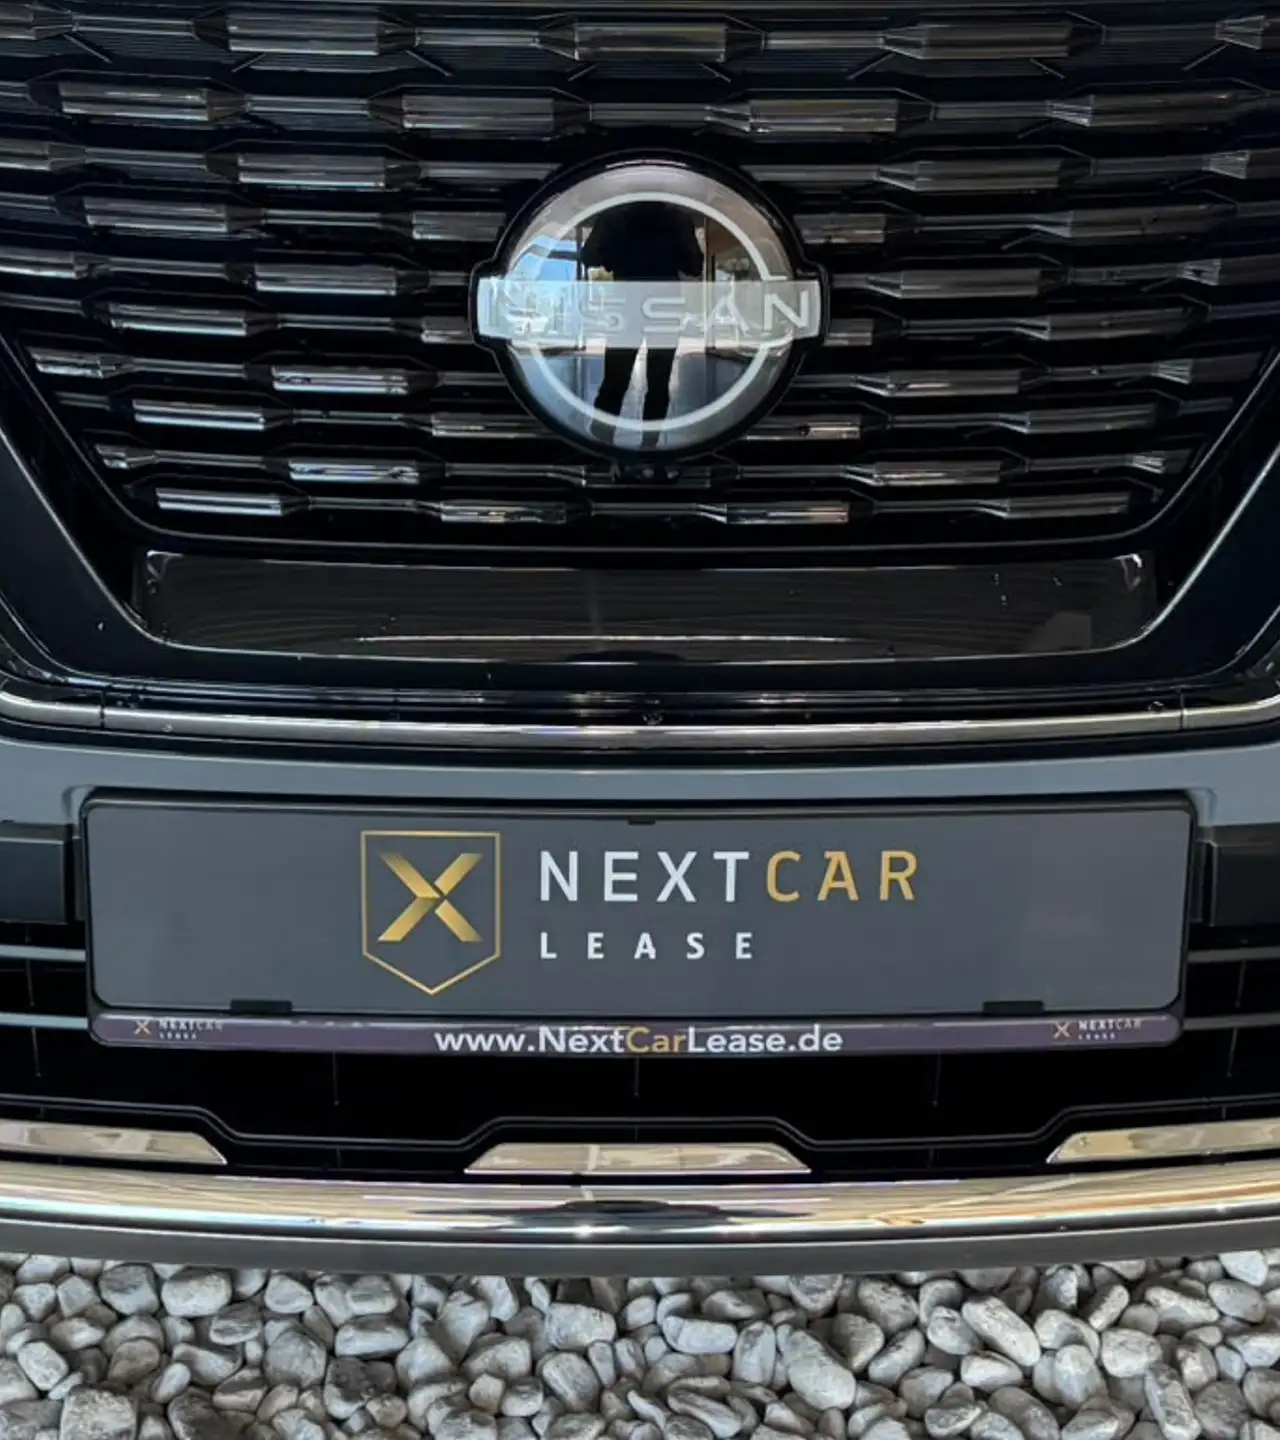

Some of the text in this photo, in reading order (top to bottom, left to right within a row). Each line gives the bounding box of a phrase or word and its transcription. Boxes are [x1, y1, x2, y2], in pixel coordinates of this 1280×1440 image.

[485, 288, 810, 336] NISSAN
[539, 850, 919, 902] NEXTCAR
[539, 931, 754, 960] LEASE
[434, 1023, 844, 1054] www.NextCarLease.de
